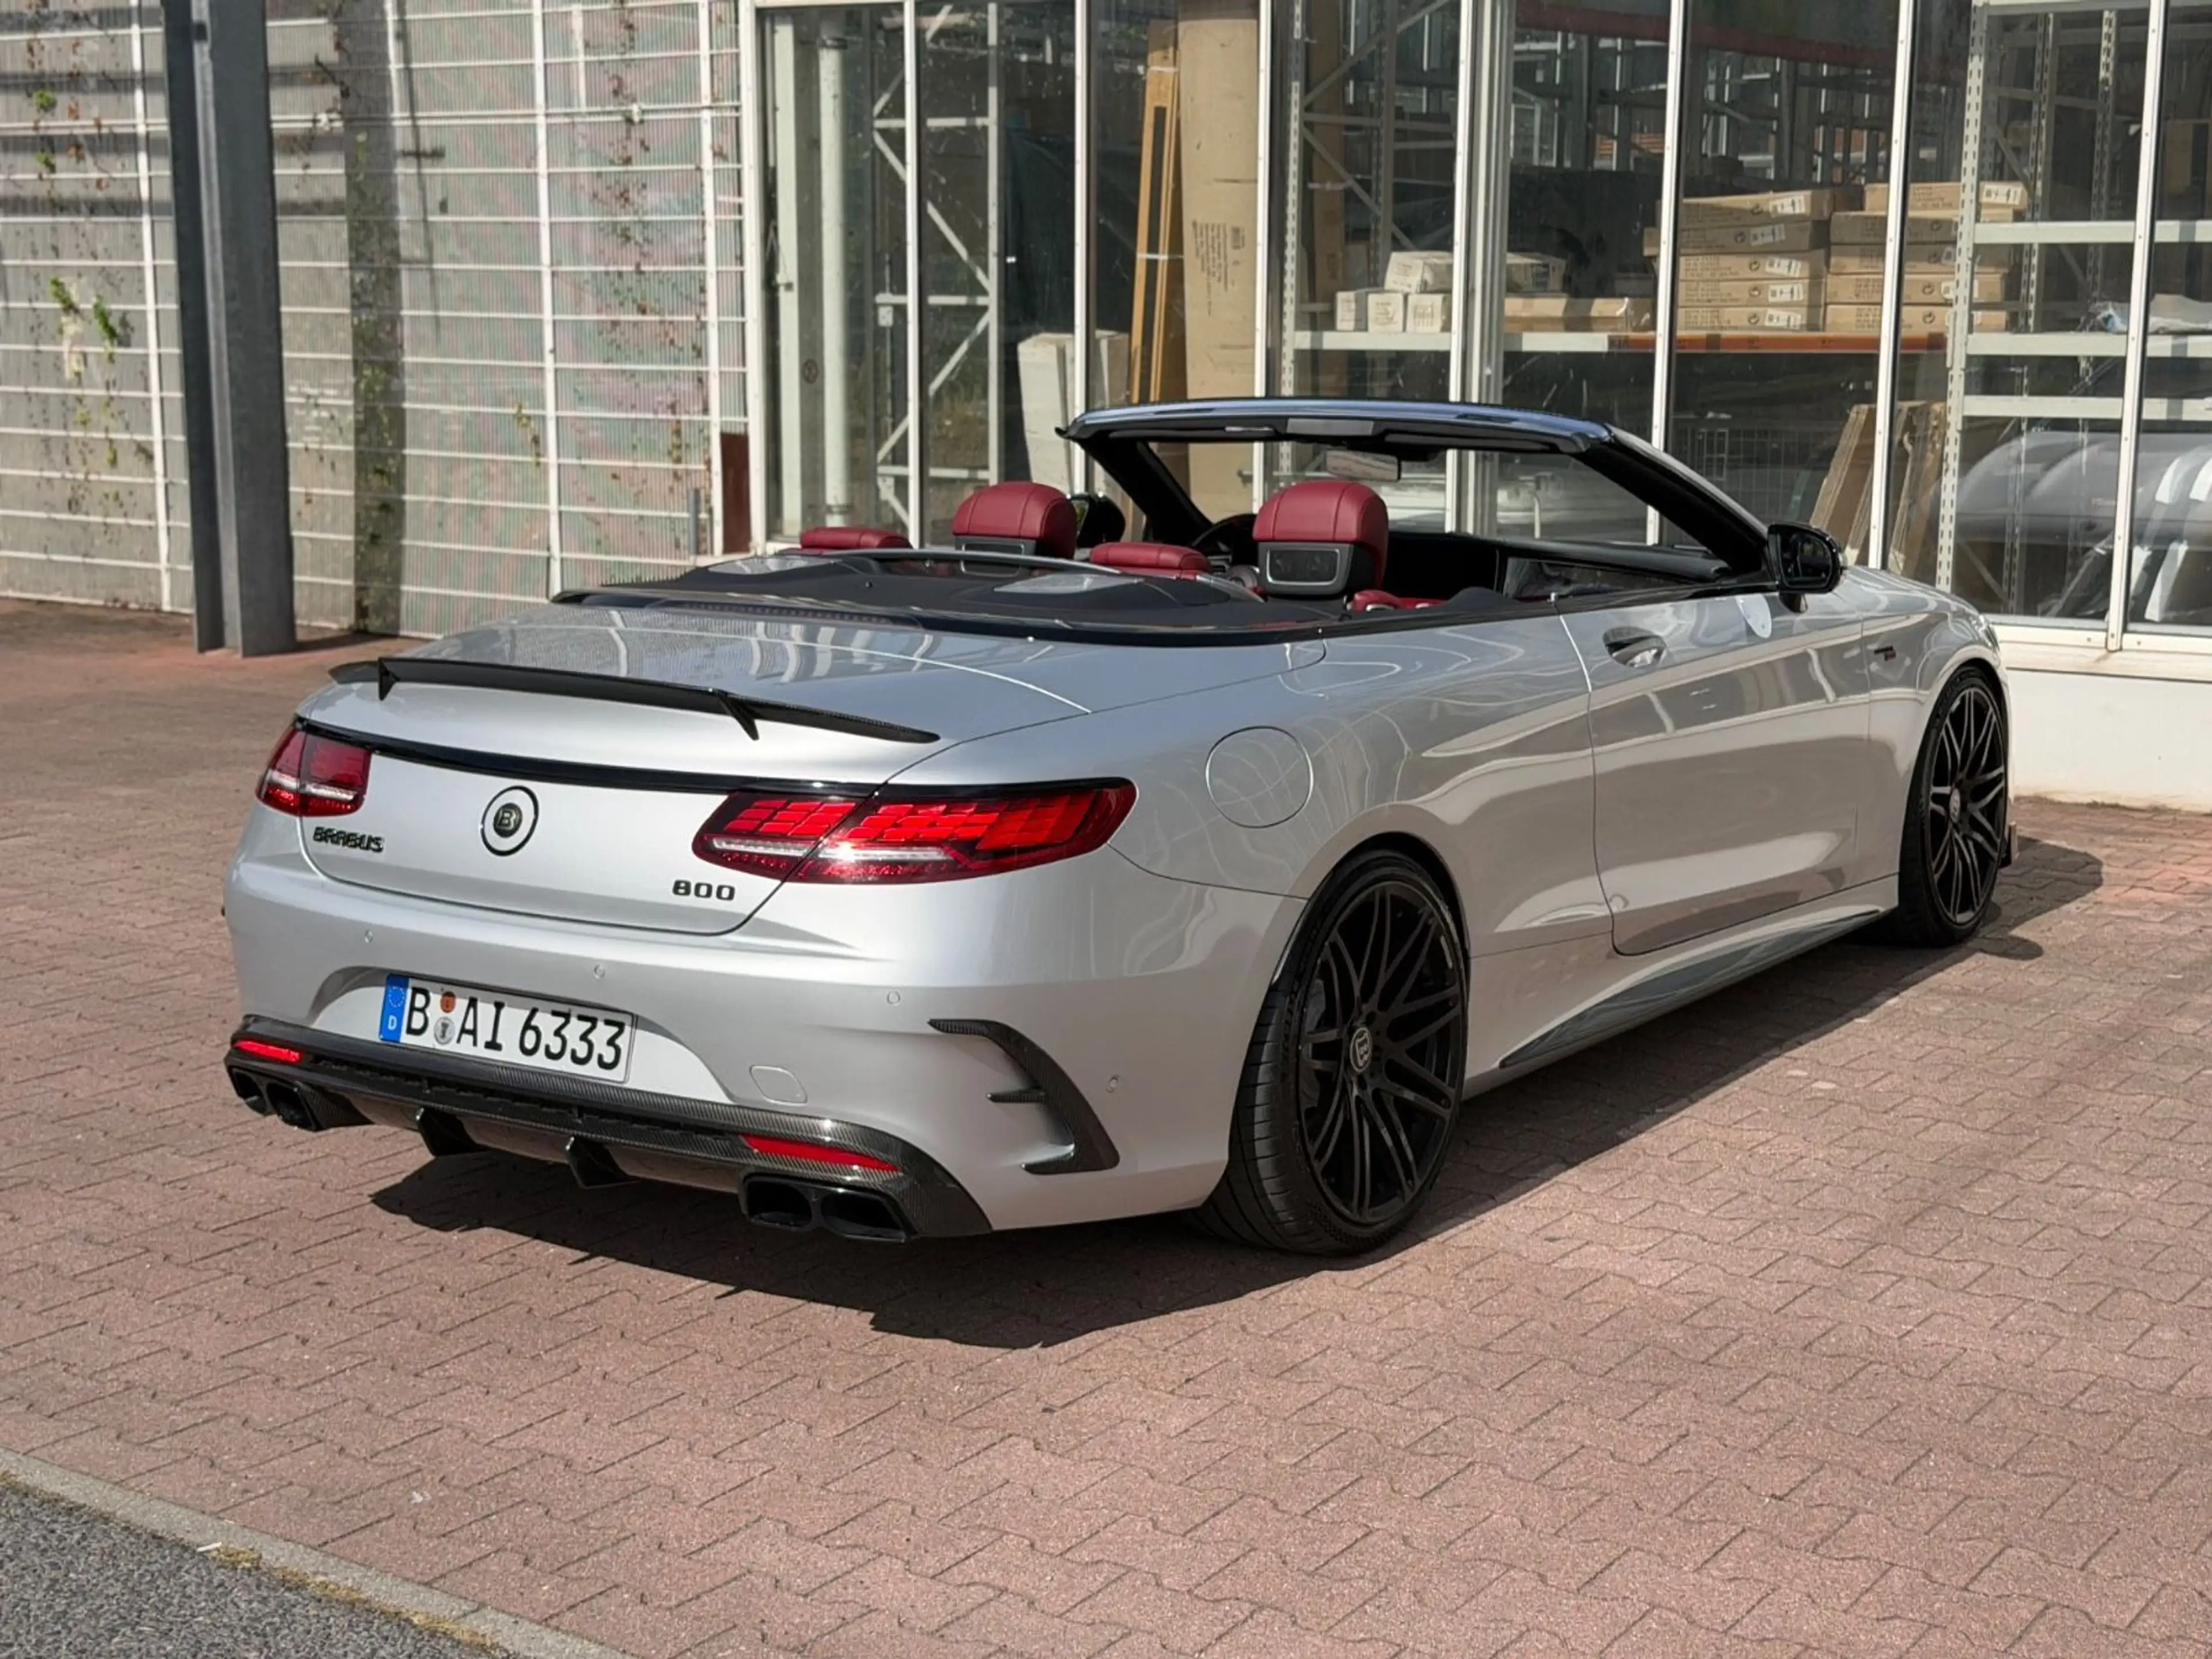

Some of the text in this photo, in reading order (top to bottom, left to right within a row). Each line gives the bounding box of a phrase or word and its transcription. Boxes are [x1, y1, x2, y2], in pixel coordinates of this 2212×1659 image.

[313, 826, 385, 853] BRABUS
[672, 879, 736, 902] 800
[388, 1015, 397, 1030] D
[406, 987, 626, 1070] B AI 6333
